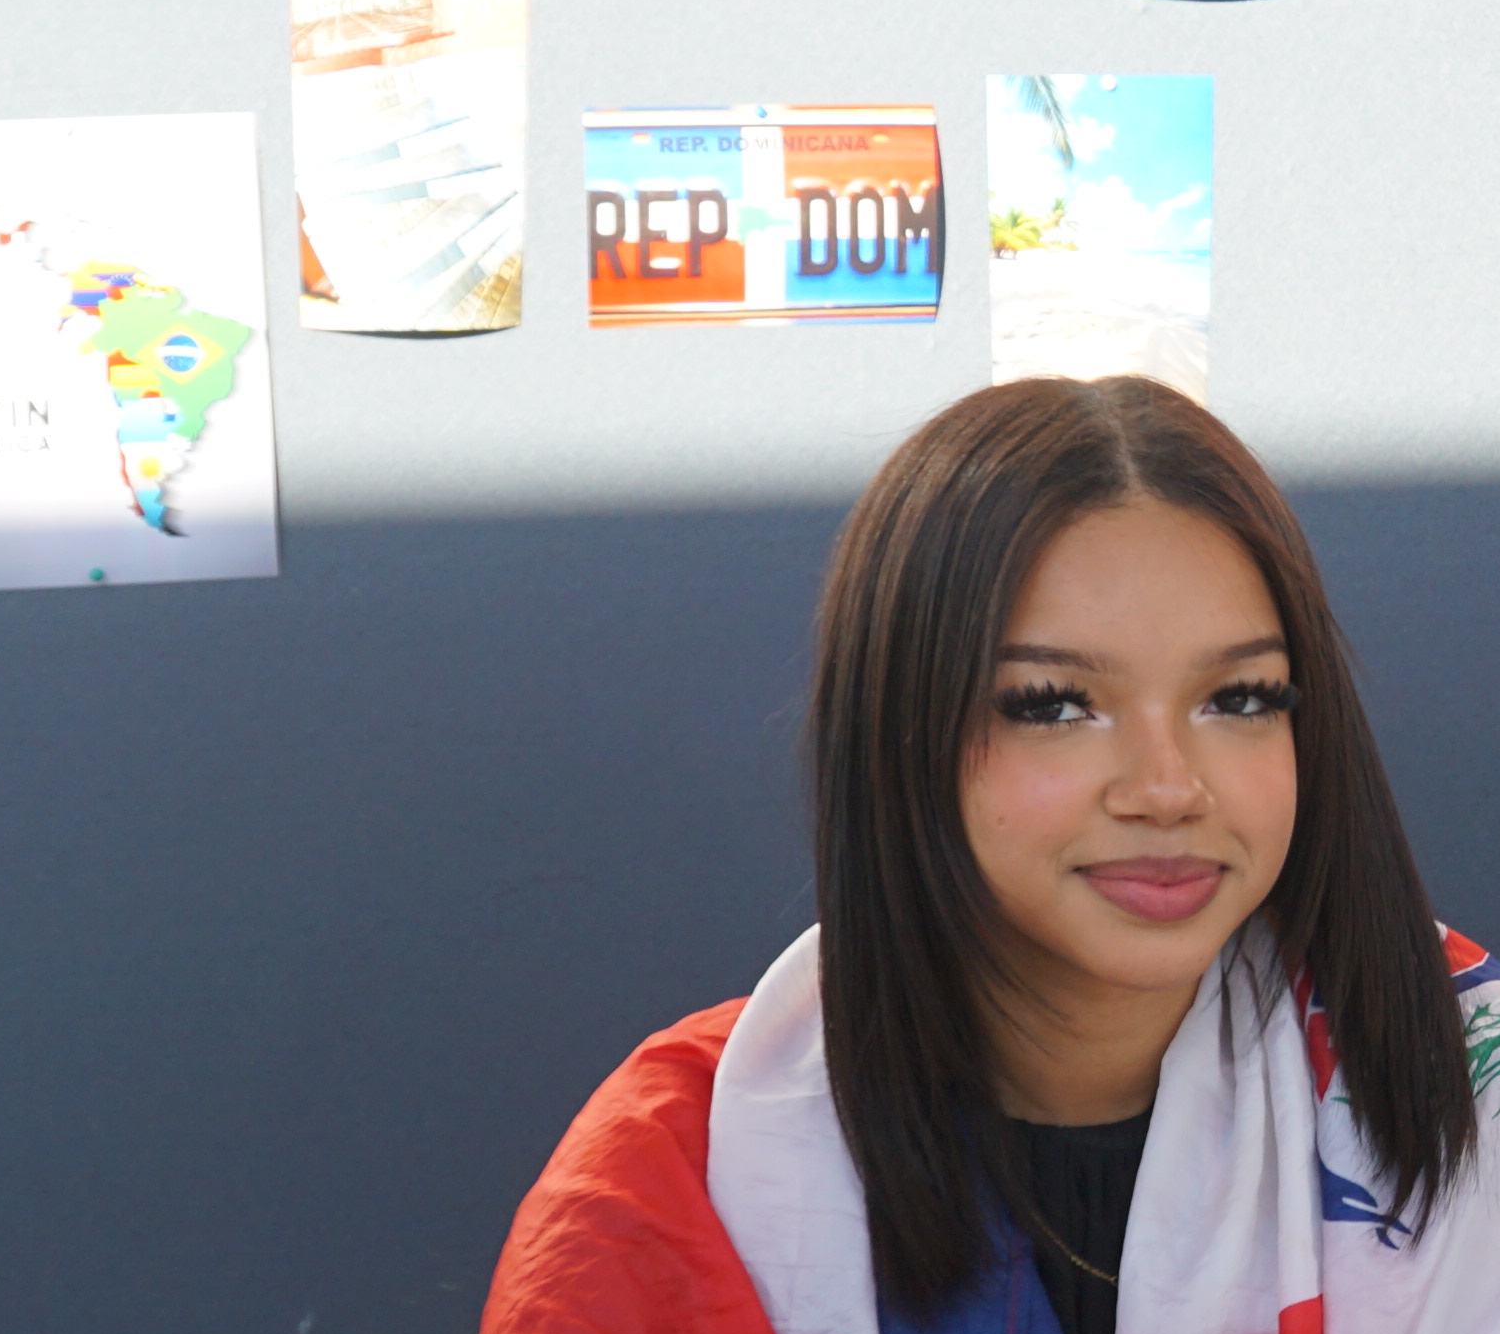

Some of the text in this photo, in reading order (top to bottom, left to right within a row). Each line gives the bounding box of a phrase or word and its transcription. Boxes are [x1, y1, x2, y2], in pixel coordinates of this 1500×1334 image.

[658, 134, 872, 153] REP. DOMINICANA
[585, 185, 939, 280] REP DOM
